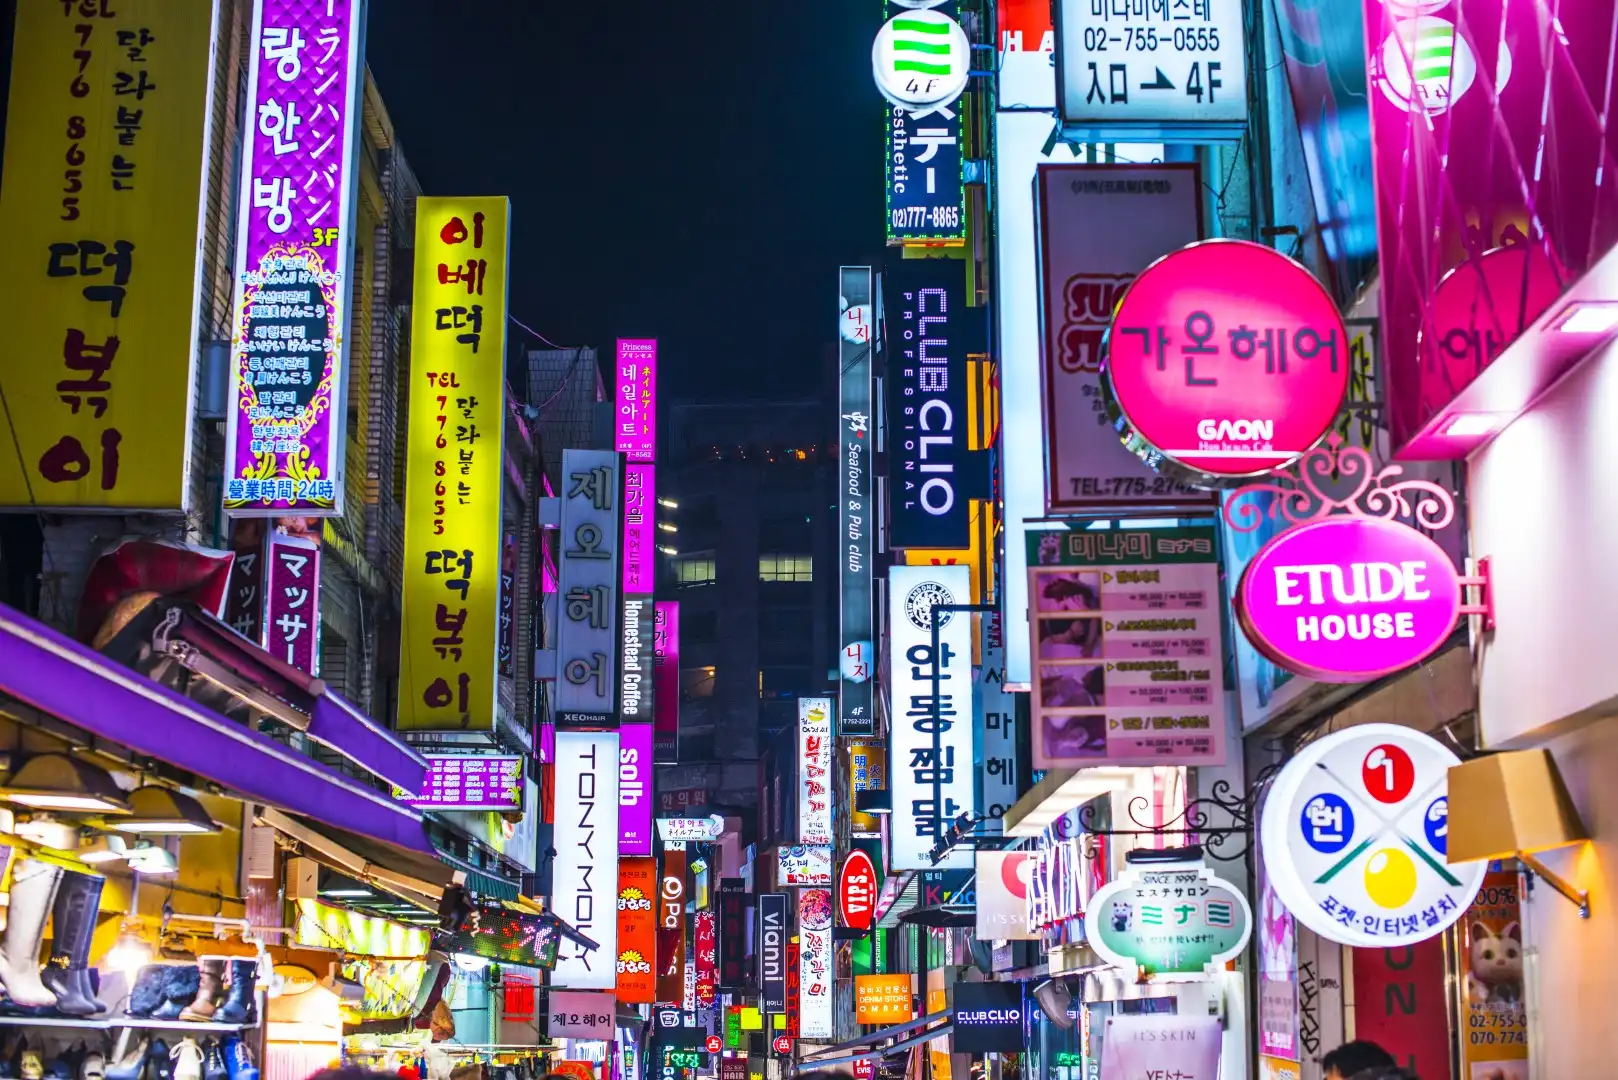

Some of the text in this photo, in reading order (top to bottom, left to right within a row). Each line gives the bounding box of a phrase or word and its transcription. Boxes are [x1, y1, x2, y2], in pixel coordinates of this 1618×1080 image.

[1084, 27, 1220, 51] 02-755-0555
[905, 78, 940, 94] 4F
[1087, 61, 1222, 104] 入口 4F
[60, 24, 93, 221] 776 8655
[893, 207, 958, 228] 02)777-8865
[311, 228, 339, 247] 3F
[622, 343, 652, 351] Princess
[1120, 310, 1338, 387] 가온헤어
[39, 240, 135, 490] 떡볶이
[426, 372, 460, 388] TEL
[620, 364, 638, 436] 네일아트
[641, 366, 651, 435] ネイルアート
[903, 292, 915, 509] PROFESSIONAL
[1196, 419, 1274, 441] GAON
[433, 395, 447, 535] 776 8655
[849, 442, 862, 496] Seafood
[918, 399, 954, 515] CLIO
[626, 472, 644, 525] 최가을
[849, 499, 861, 511] &
[849, 514, 863, 541] Pub
[1069, 533, 1152, 560] 미나미
[233, 553, 257, 634] マッサ
[564, 466, 613, 698] 제오헤어
[1273, 561, 1430, 606] ETUDE
[275, 553, 308, 666] マッサー
[423, 549, 475, 713] 떡볶이
[1296, 612, 1415, 642] HOUSE
[623, 600, 643, 715] Homestead Coffee
[851, 706, 864, 716] 4F
[619, 748, 643, 806] solb
[668, 819, 705, 829] 네일아트
[1135, 886, 1210, 898] エステサロン
[1174, 874, 1198, 883] 1999
[847, 875, 869, 914] VIPS
[1470, 886, 1516, 907] 00%
[764, 912, 783, 981] vianni
[859, 994, 908, 1004] DENIM STORE
[553, 1012, 612, 1028] 제오헤어
[988, 1010, 1020, 1021] CLIO
[1469, 1014, 1527, 1029] 02-755-0
[1470, 1031, 1528, 1045] 070-774
